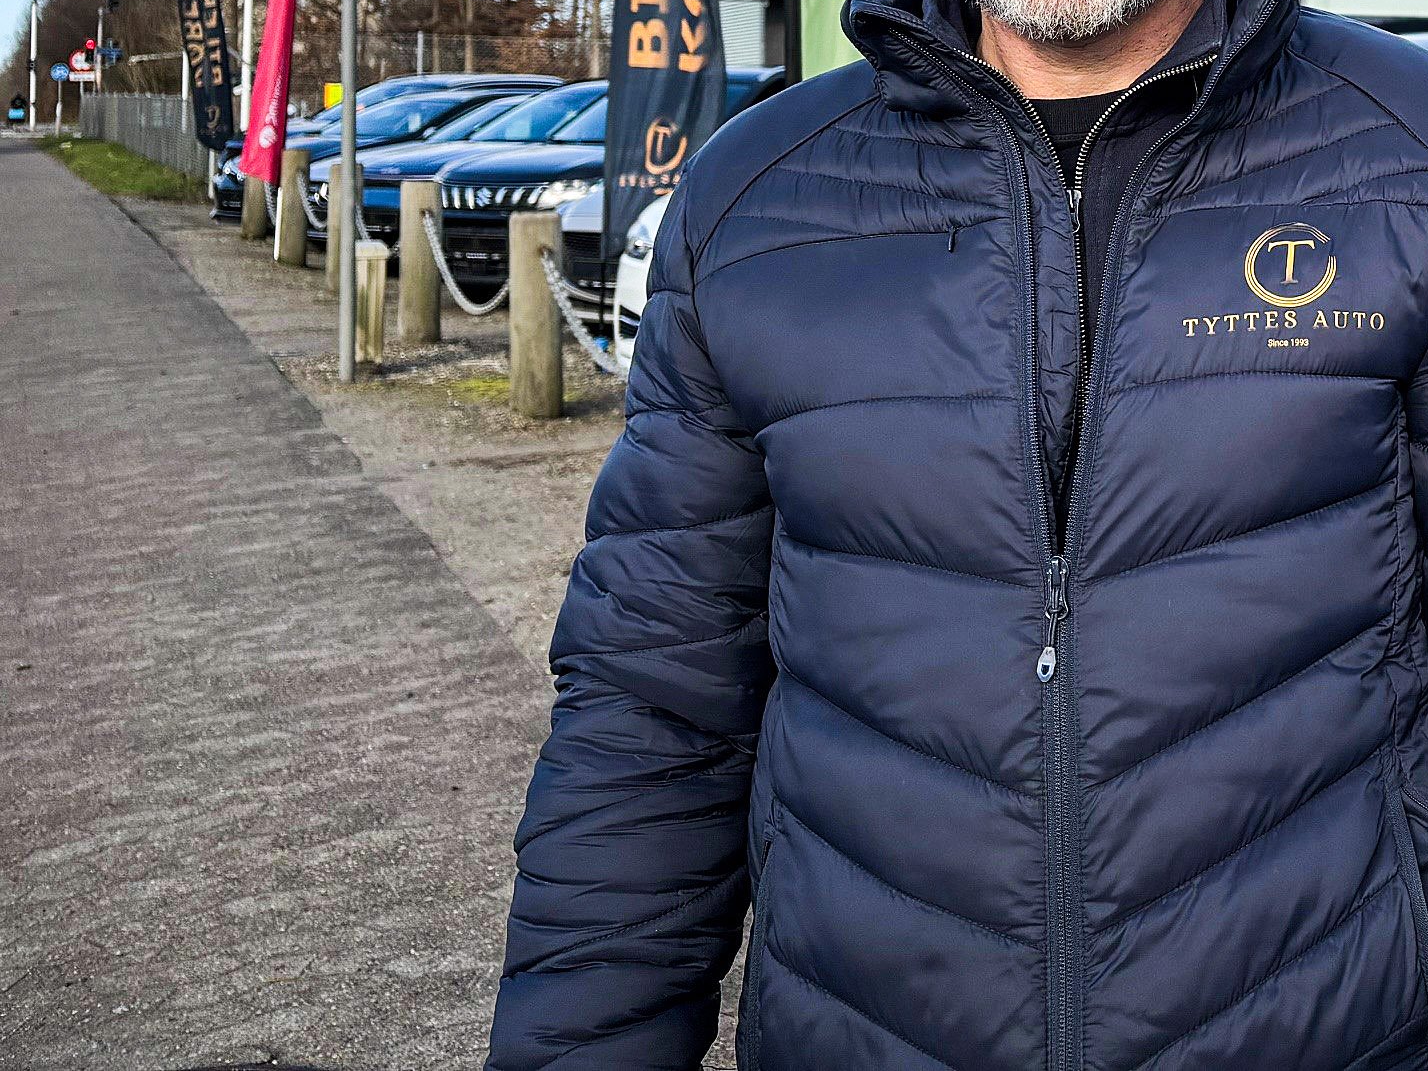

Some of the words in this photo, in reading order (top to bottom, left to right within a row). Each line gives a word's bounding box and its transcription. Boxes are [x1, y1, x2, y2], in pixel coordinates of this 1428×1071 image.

[1182, 310, 1297, 337] TYTTES
[1312, 310, 1386, 331] AUTO
[1267, 338, 1289, 348] Since
[1291, 338, 1310, 347] 1993
